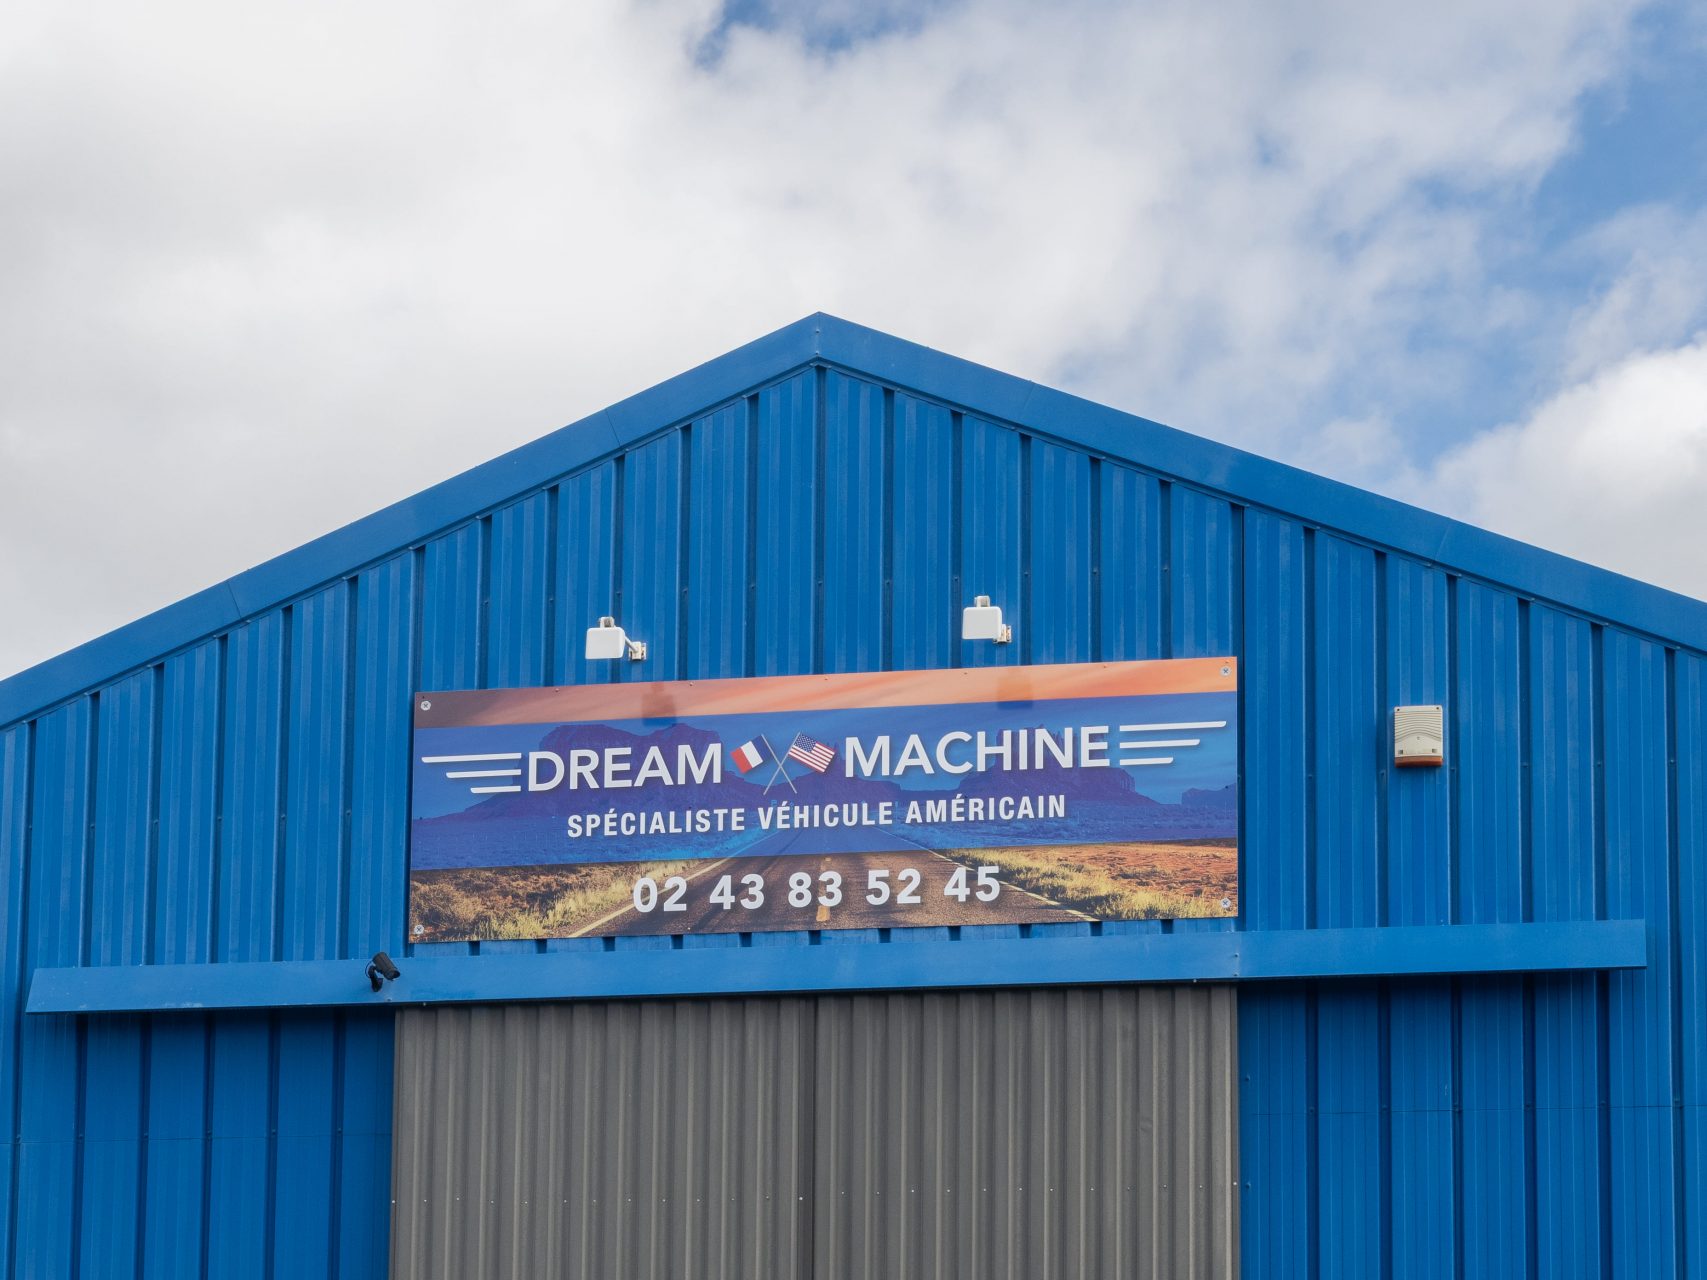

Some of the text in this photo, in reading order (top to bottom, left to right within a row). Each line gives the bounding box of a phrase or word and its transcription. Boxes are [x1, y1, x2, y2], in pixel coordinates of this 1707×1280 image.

[528, 725, 1110, 792] DREAM MACHINE
[567, 794, 1065, 838] SPÉCIALISTE VÉHICULE AMÉRICAIN
[633, 866, 1001, 912] 02 43 83 52 45
